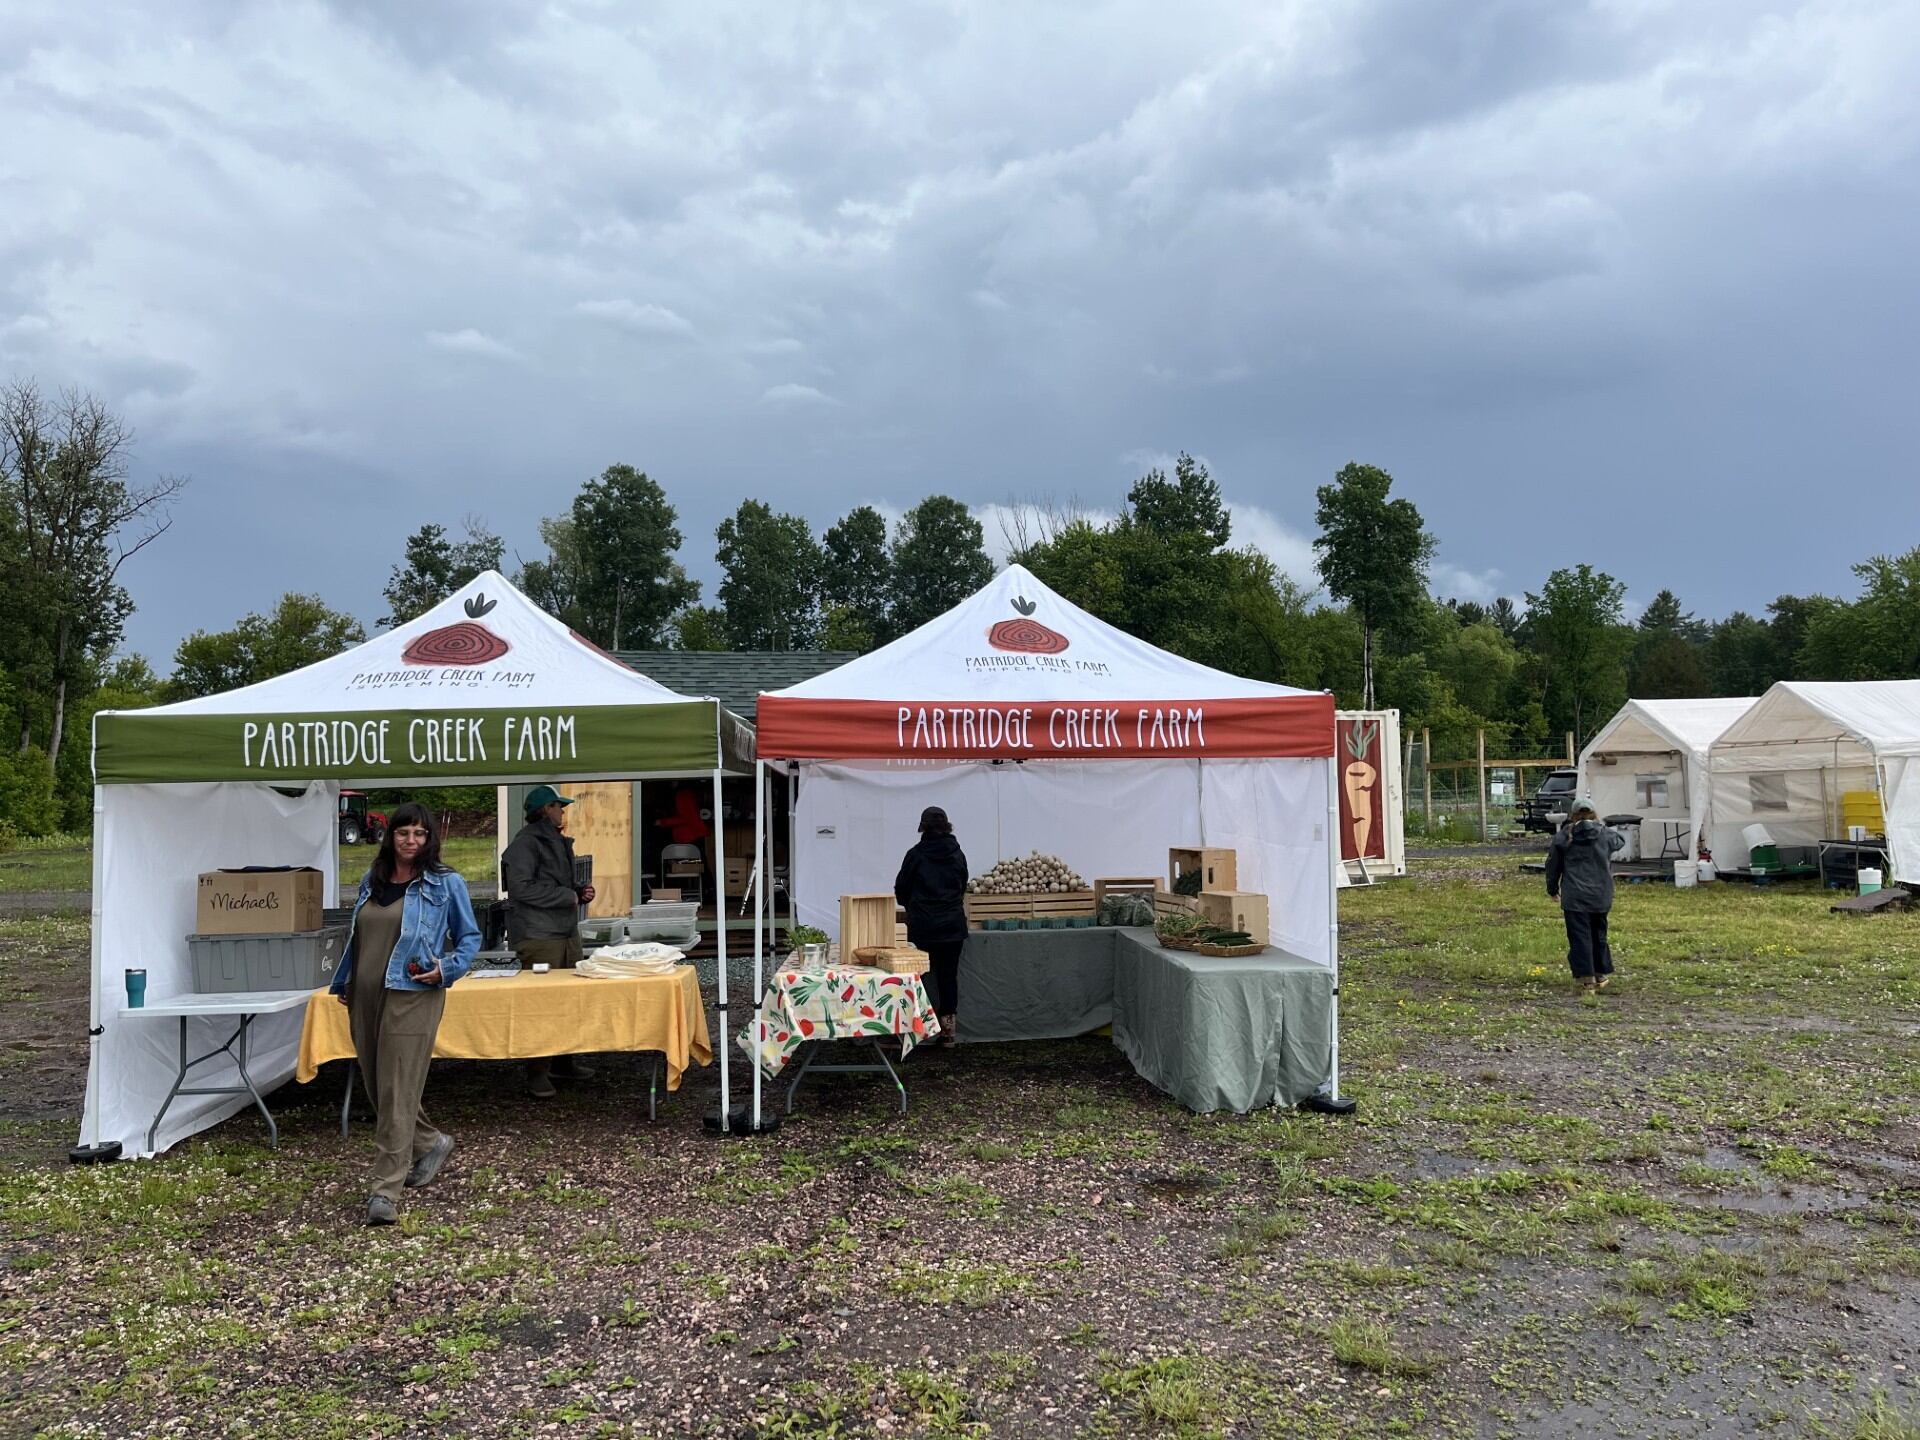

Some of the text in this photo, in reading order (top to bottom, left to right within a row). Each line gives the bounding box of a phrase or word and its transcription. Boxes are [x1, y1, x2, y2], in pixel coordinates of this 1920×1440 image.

[965, 655, 1110, 672] PARTRIDGE CREEK FARM
[351, 668, 536, 684] PARTRIDGE CREEK FARM
[897, 707, 1205, 748] PARTRIDGE CREEK FARM
[243, 715, 576, 767] PARTRIDGE CREEK FARM
[210, 891, 279, 911] Michaels
